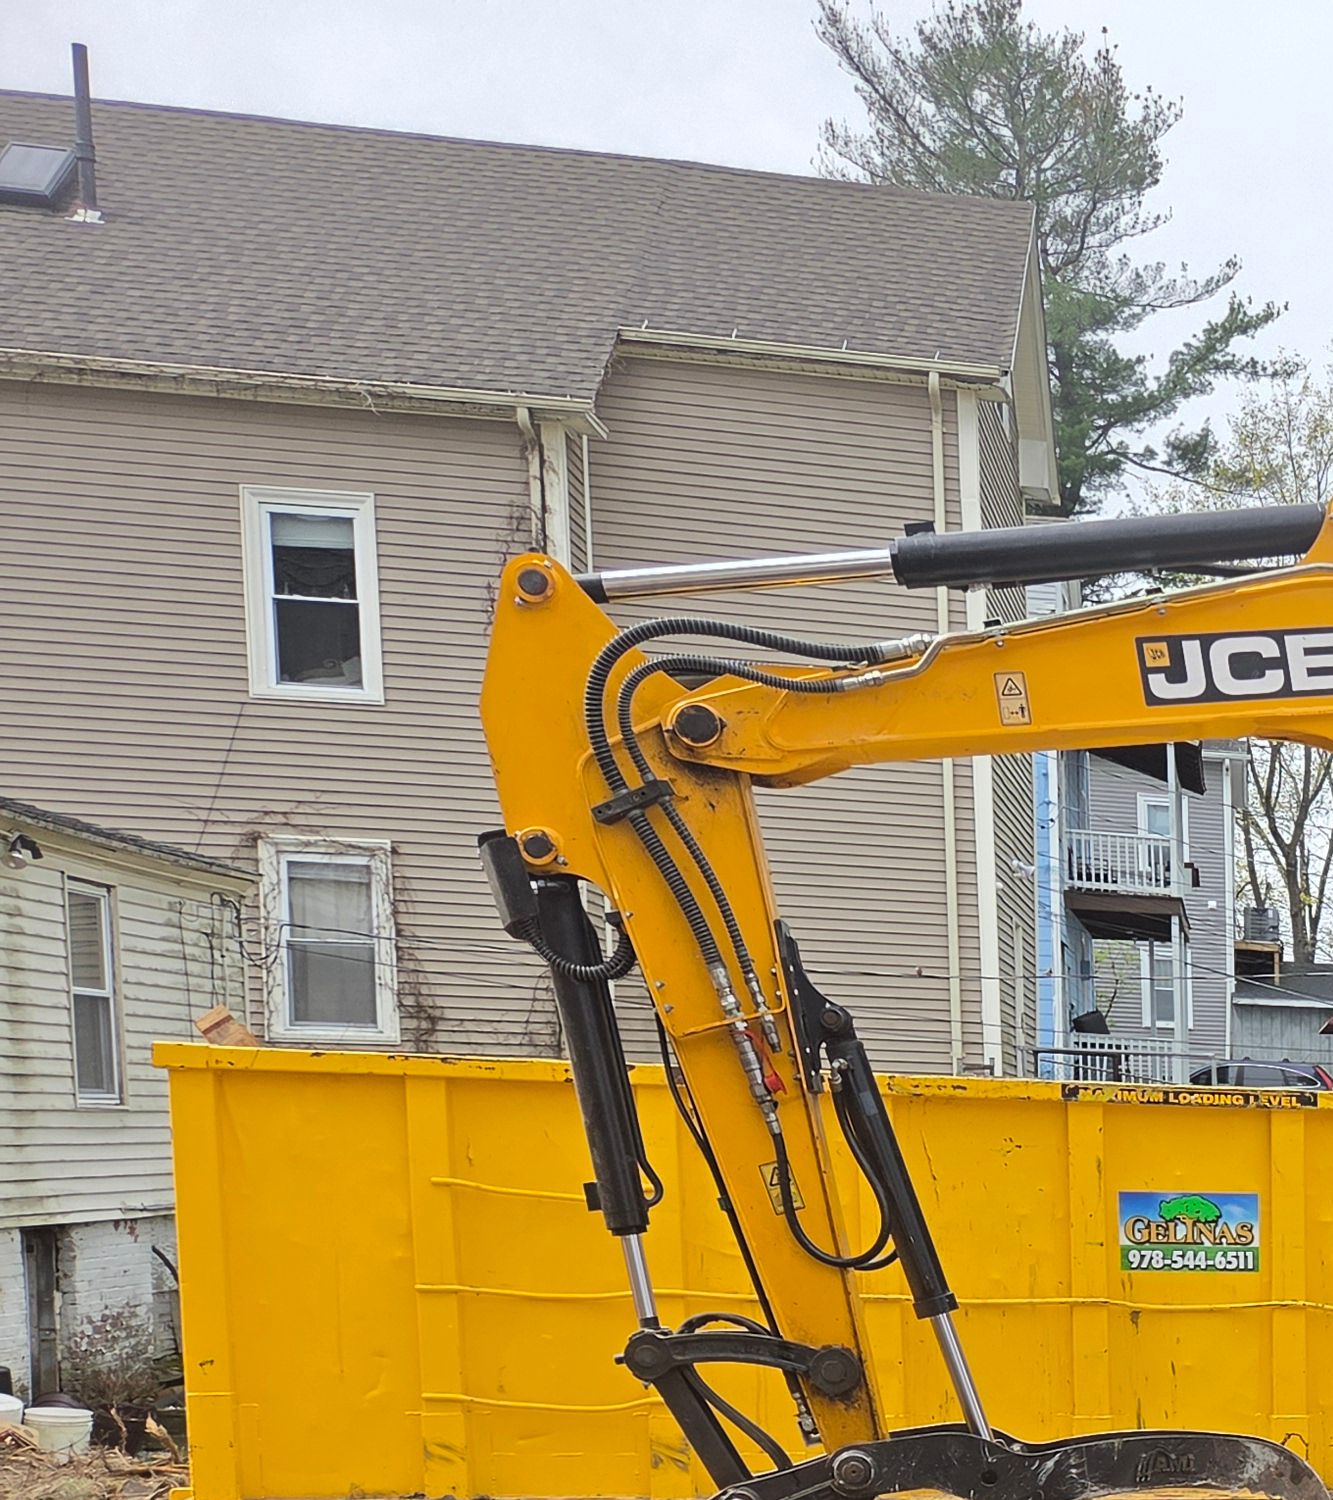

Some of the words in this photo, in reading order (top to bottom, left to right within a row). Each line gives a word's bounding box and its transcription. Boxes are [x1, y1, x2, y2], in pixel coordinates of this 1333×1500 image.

[1168, 1092, 1244, 1106] LOADING
[1249, 1095, 1301, 1107] LEVEL
[1124, 1215, 1254, 1245] GELINAS
[1127, 1249, 1255, 1271] 978-544-6511
